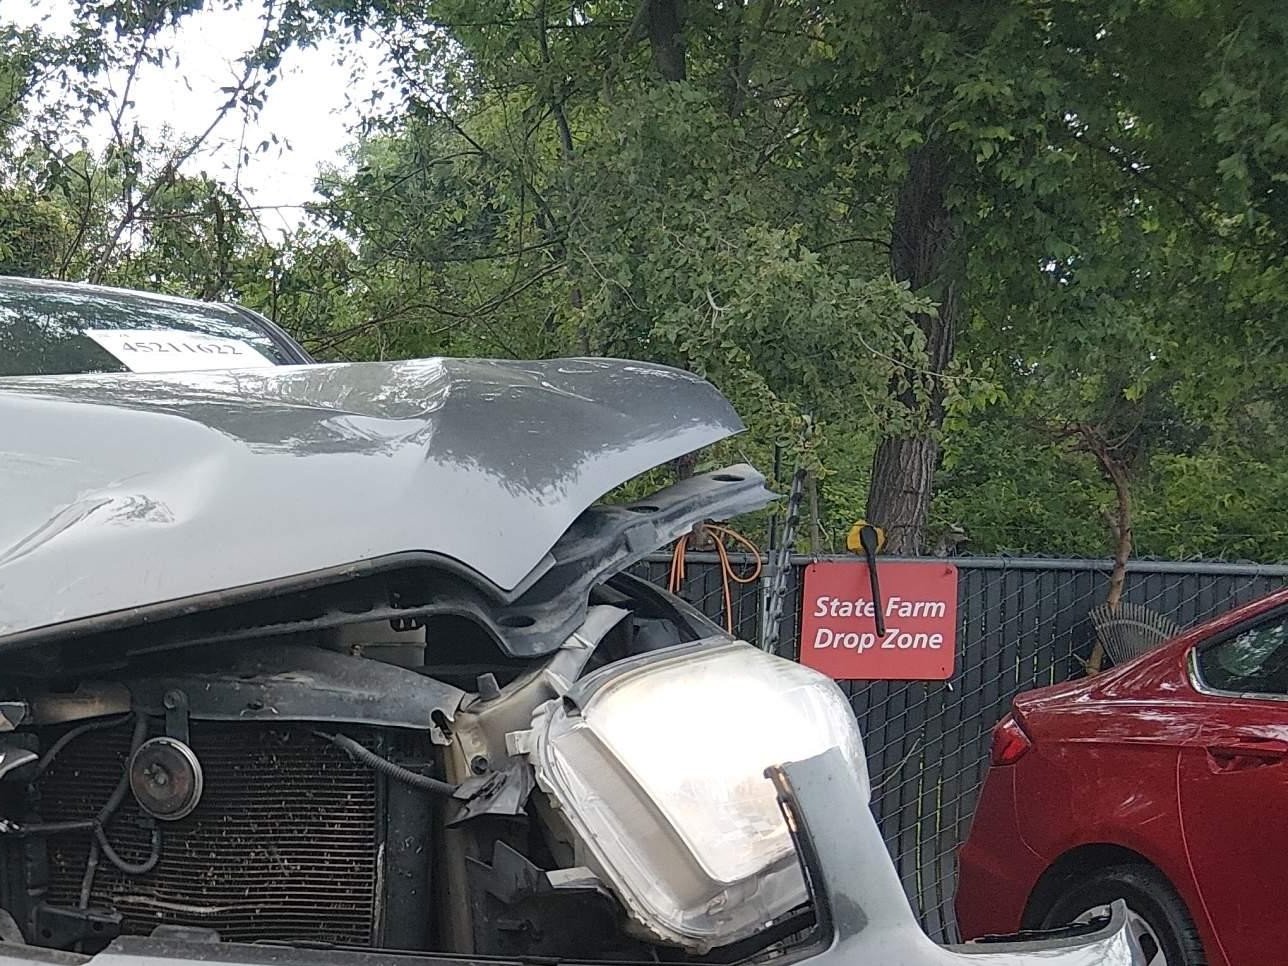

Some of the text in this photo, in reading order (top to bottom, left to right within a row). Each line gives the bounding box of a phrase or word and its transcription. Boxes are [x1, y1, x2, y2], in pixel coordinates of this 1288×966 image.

[122, 341, 243, 355] 45211622
[814, 596, 946, 618] State Farm
[814, 628, 943, 654] Drop Zone
